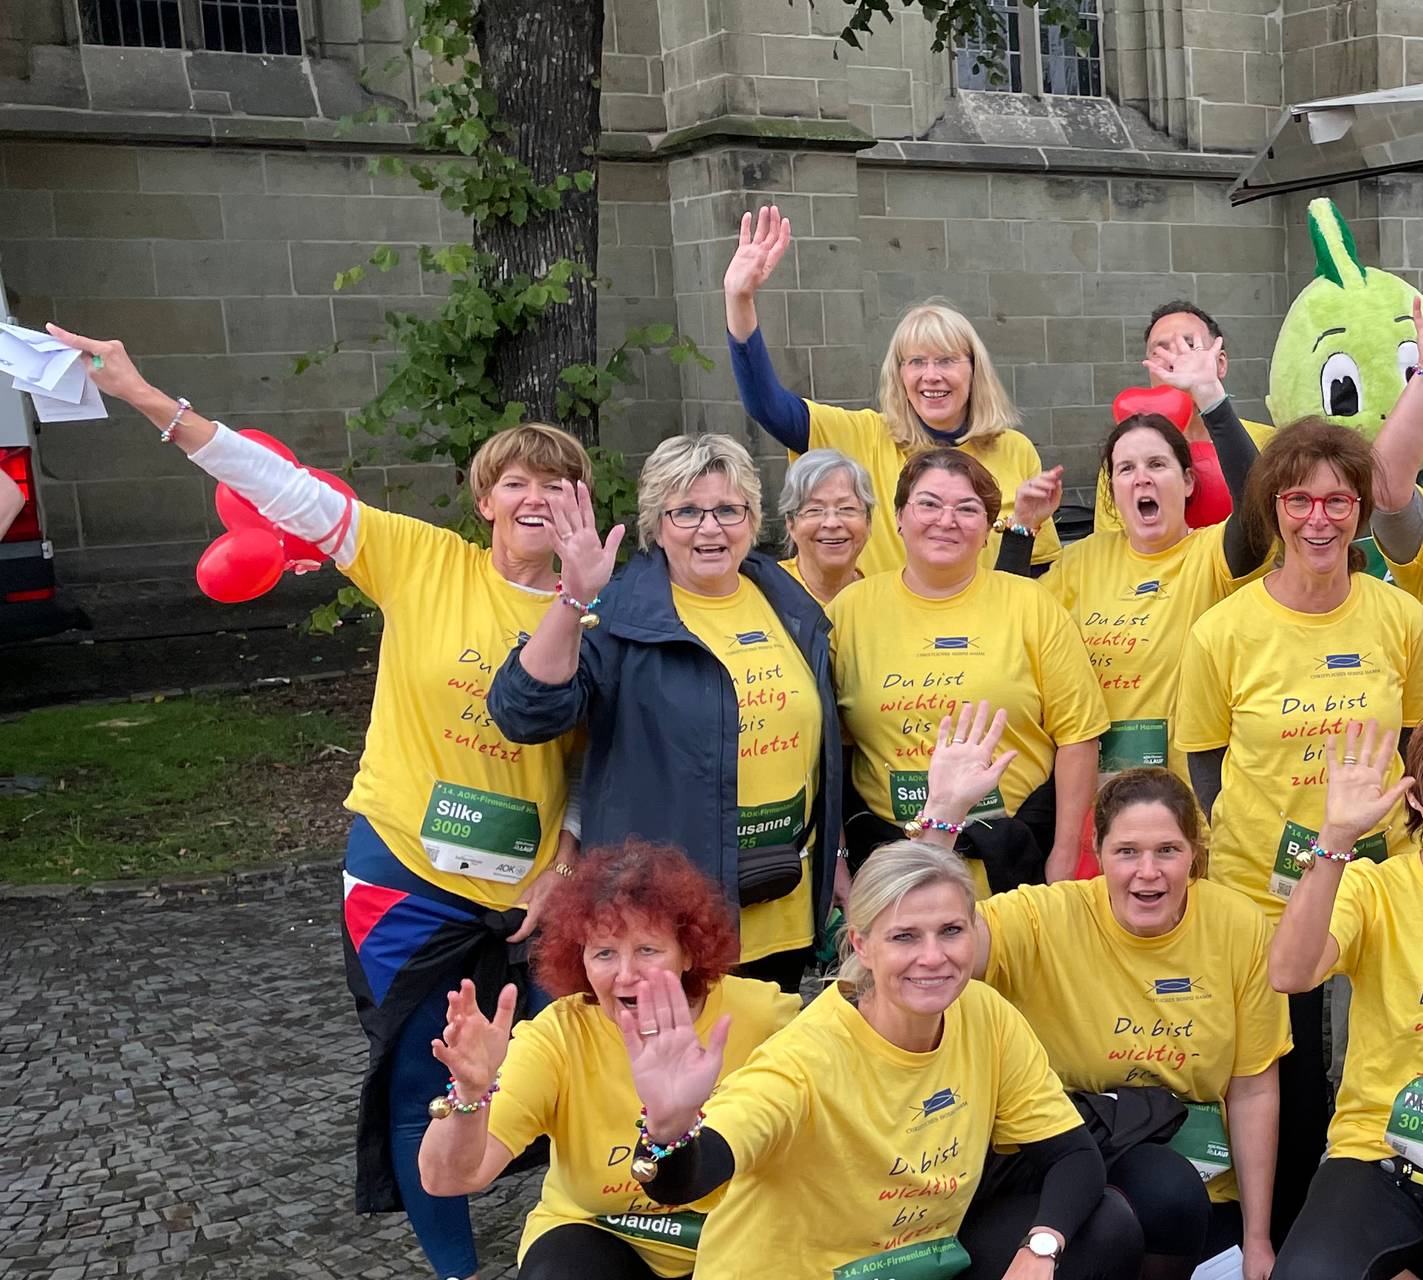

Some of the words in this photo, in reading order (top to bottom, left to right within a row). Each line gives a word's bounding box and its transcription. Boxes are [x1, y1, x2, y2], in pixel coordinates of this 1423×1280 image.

[1085, 612, 1108, 626] Du
[1113, 613, 1150, 626] bist
[458, 648, 492, 674] Du
[1090, 652, 1112, 667] bis
[746, 664, 784, 684] bist
[883, 674, 914, 688] Du
[923, 671, 964, 687] bist
[1098, 673, 1141, 689] letzt
[1282, 698, 1315, 714] Du
[1325, 692, 1368, 712] bist
[902, 718, 932, 735] bis
[443, 728, 522, 763] zuletzt
[740, 731, 799, 758] uletzt
[895, 740, 936, 758] zule
[1303, 743, 1325, 761] bi
[897, 786, 928, 801] Sati
[436, 800, 483, 823] Silke
[431, 818, 471, 838] 3009
[737, 816, 791, 836] usanne
[1114, 1017, 1145, 1034] Du
[1151, 1019, 1193, 1037] bist
[921, 1137, 959, 1174] bist
[892, 1206, 927, 1228] bis
[862, 1247, 931, 1273] AOK-Firmenlauf
